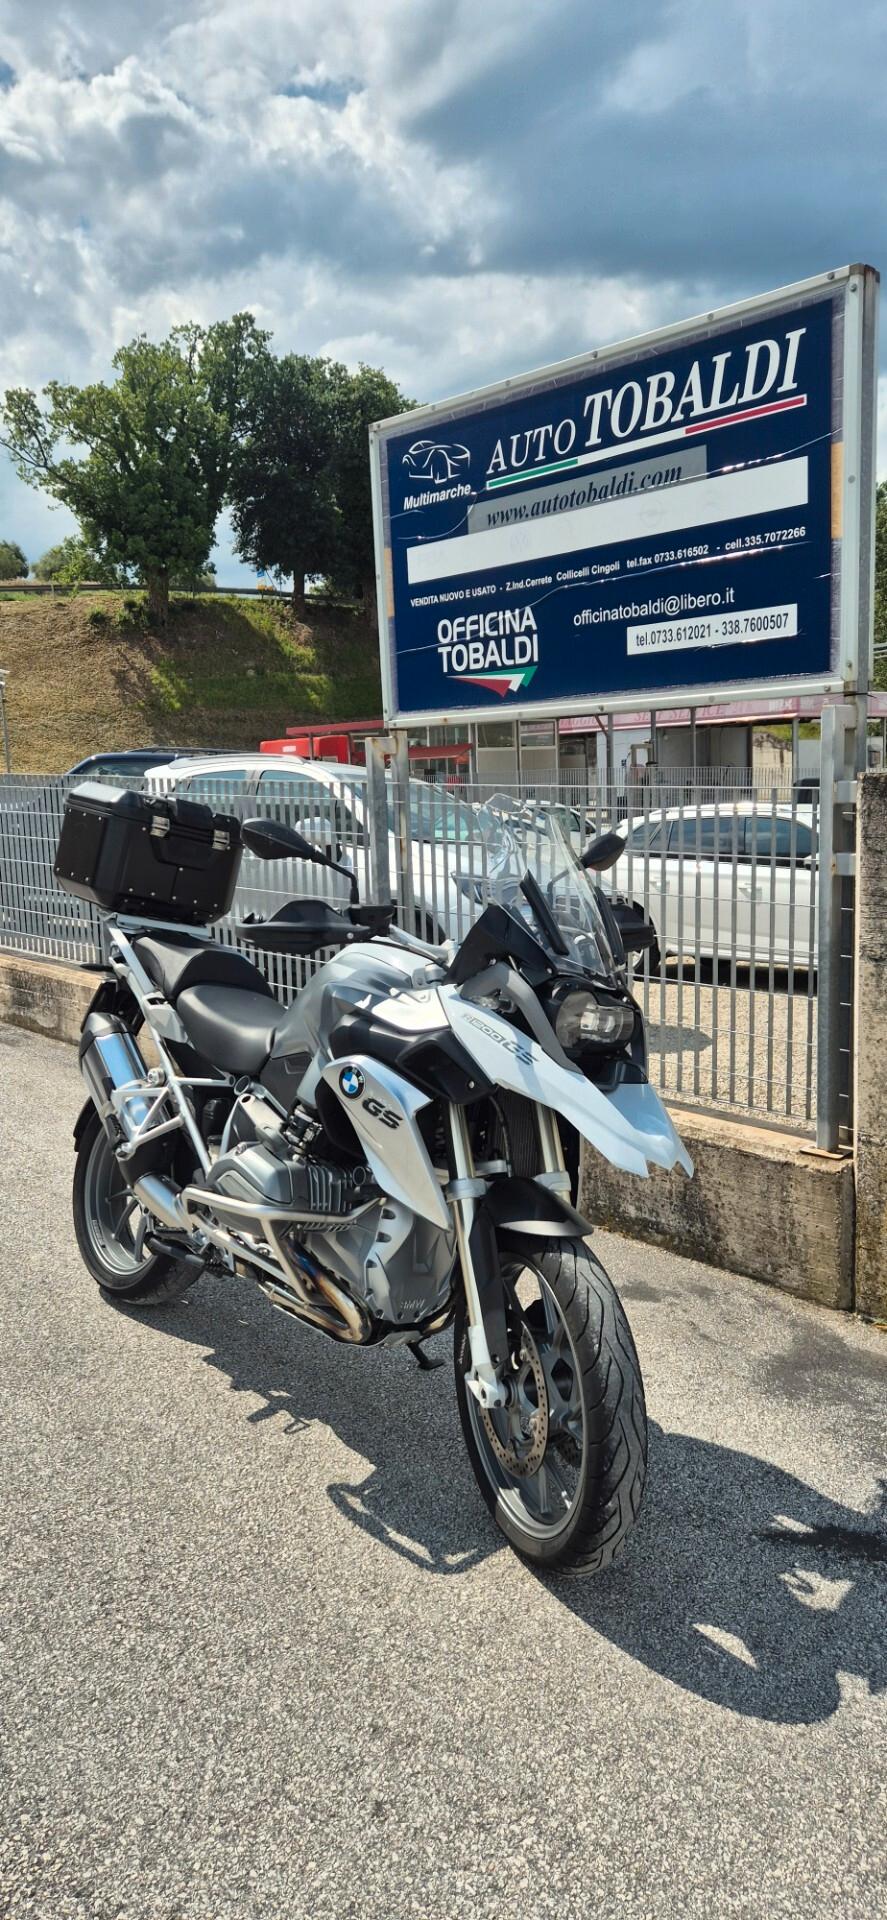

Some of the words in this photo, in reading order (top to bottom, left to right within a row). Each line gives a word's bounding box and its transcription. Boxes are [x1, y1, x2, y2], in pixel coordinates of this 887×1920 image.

[486, 419, 576, 474] AUTO
[583, 328, 807, 447] TOBALDI
[403, 483, 471, 510] Multimarche
[487, 466, 682, 527] www.autotobaldi.com
[410, 595, 439, 607] VENDITA
[439, 590, 465, 602] NUOVO
[465, 588, 471, 598] E
[471, 584, 496, 597] USATO
[505, 575, 552, 591] Z.Ind.Cerrete
[556, 567, 590, 581] Collicelli
[591, 561, 620, 576] Cingoli
[626, 555, 652, 569] tel.fax
[654, 545, 709, 563] 0733.616502
[725, 526, 806, 551] cell.335.7072266
[437, 606, 538, 643] OFFICINA
[573, 587, 735, 626] officinatobaldi@libero.it
[636, 624, 712, 647] tel.0733.612021
[721, 613, 789, 636] 338.7600507
[437, 634, 539, 673] TOBALDI
[362, 1097, 403, 1129] GS
